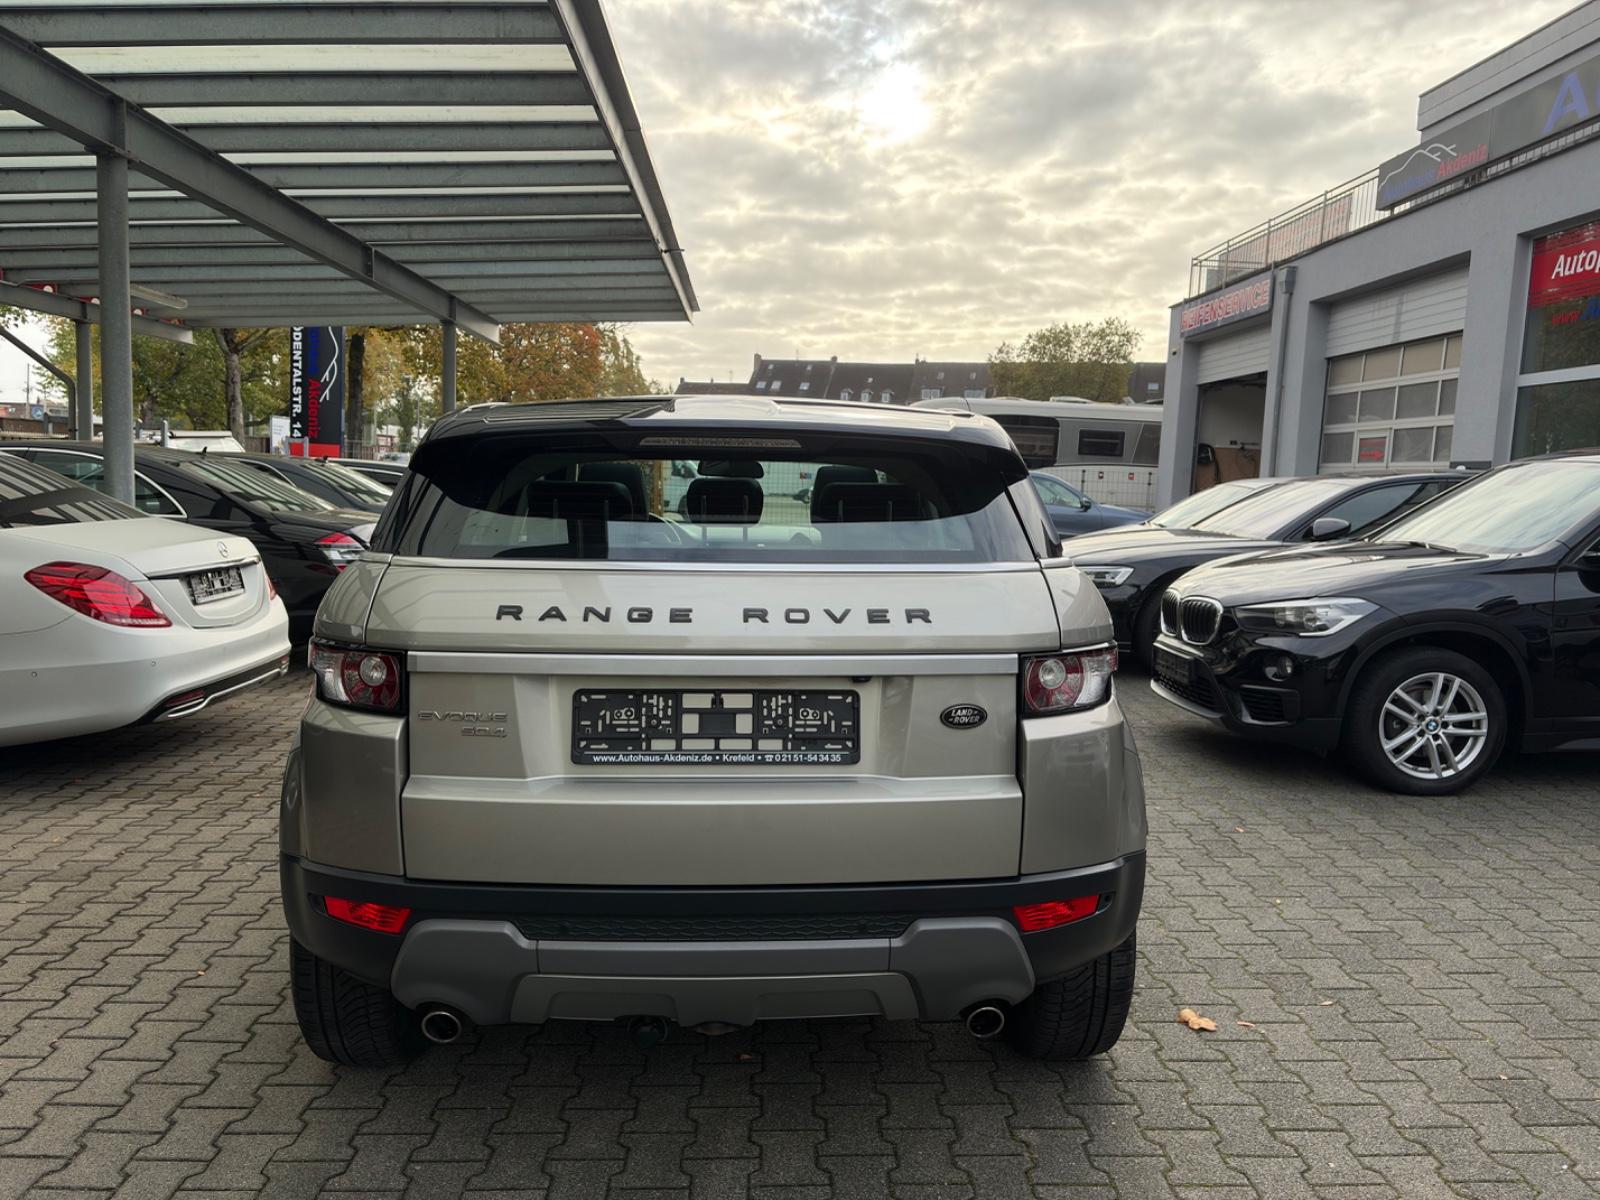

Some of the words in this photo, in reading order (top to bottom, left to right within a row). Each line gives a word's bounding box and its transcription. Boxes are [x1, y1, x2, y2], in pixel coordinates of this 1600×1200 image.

[1540, 71, 1600, 135] A
[1180, 279, 1270, 333] REIFENSERVICE
[307, 379, 321, 438] Akdeniz
[292, 421, 303, 438] 14
[496, 604, 693, 624] RANGE
[743, 607, 933, 625] ROVER
[418, 710, 508, 722] EVOQUE
[592, 753, 713, 763] www.Autohaus-Akdeniz.de
[722, 753, 755, 763] Krefeld
